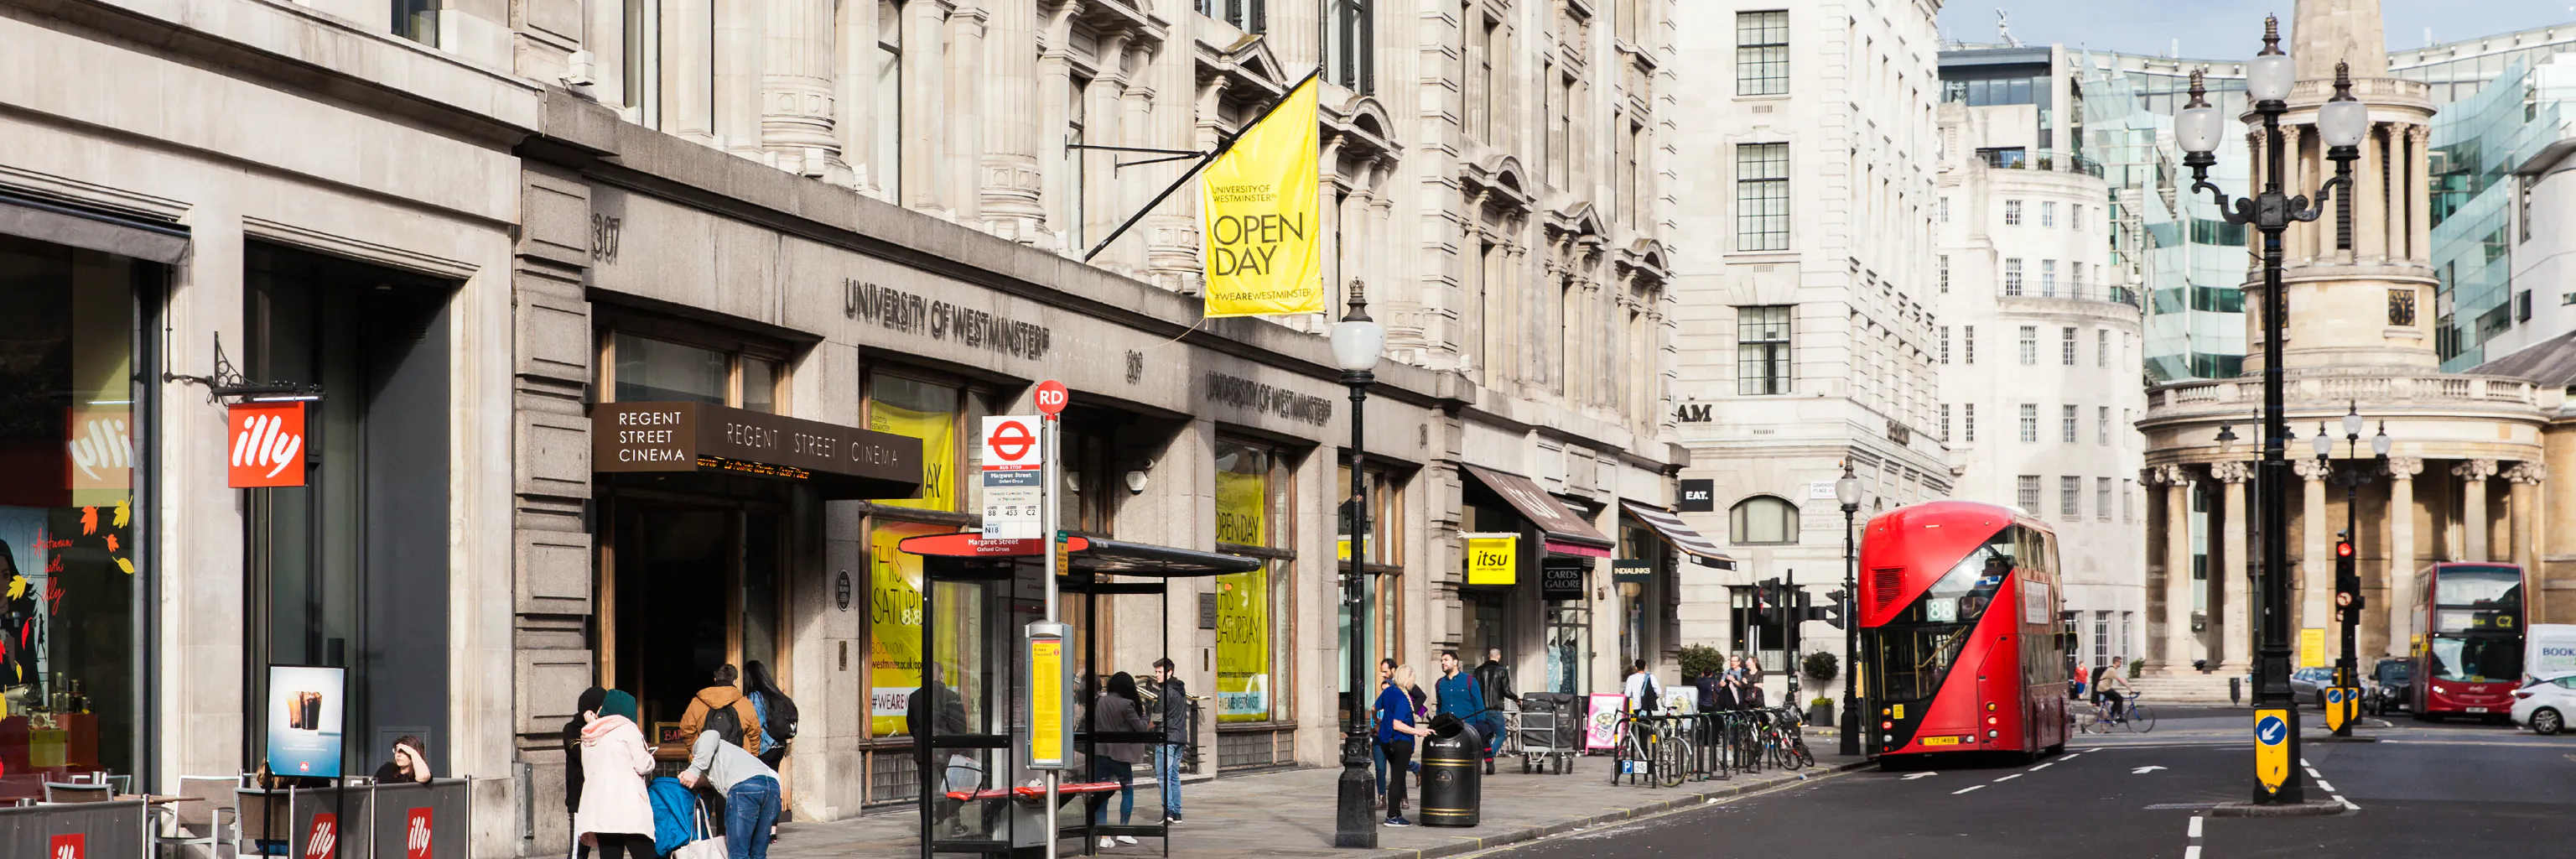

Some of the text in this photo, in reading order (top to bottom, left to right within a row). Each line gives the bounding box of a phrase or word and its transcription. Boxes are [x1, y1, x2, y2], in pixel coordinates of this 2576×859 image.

[1212, 185, 1258, 194] UNIVERSITY
[1213, 194, 1272, 202] WESTMINSTER
[593, 213, 621, 260] 307
[1213, 212, 1303, 246] OPEN
[1215, 245, 1277, 276] DAY
[1215, 289, 1312, 301] #WEAREWESTMINSTER
[844, 278, 1043, 360] UNIVERSITY OF WESTMINSTER
[1040, 390, 1063, 404] RD
[1207, 370, 1258, 409] UNIVERSITY
[1259, 383, 1271, 413] OF
[619, 412, 681, 425] REGENT
[232, 414, 301, 477] illy
[619, 430, 673, 444] STREET
[727, 423, 898, 467] REGENT STREET CINEMA
[619, 449, 685, 462] CINEMA
[925, 463, 942, 498] AY
[1685, 491, 1709, 500] EAT.
[1241, 514, 1259, 544] DAY
[872, 545, 902, 582] THIS
[1477, 550, 1508, 566] itsu
[1547, 570, 1578, 579] CARDS
[1545, 580, 1581, 588] GALORE
[1929, 601, 1953, 619] 88
[2496, 616, 2513, 627] C2
[1624, 762, 1631, 772] P
[307, 822, 335, 859] illy
[408, 816, 430, 852] illy
